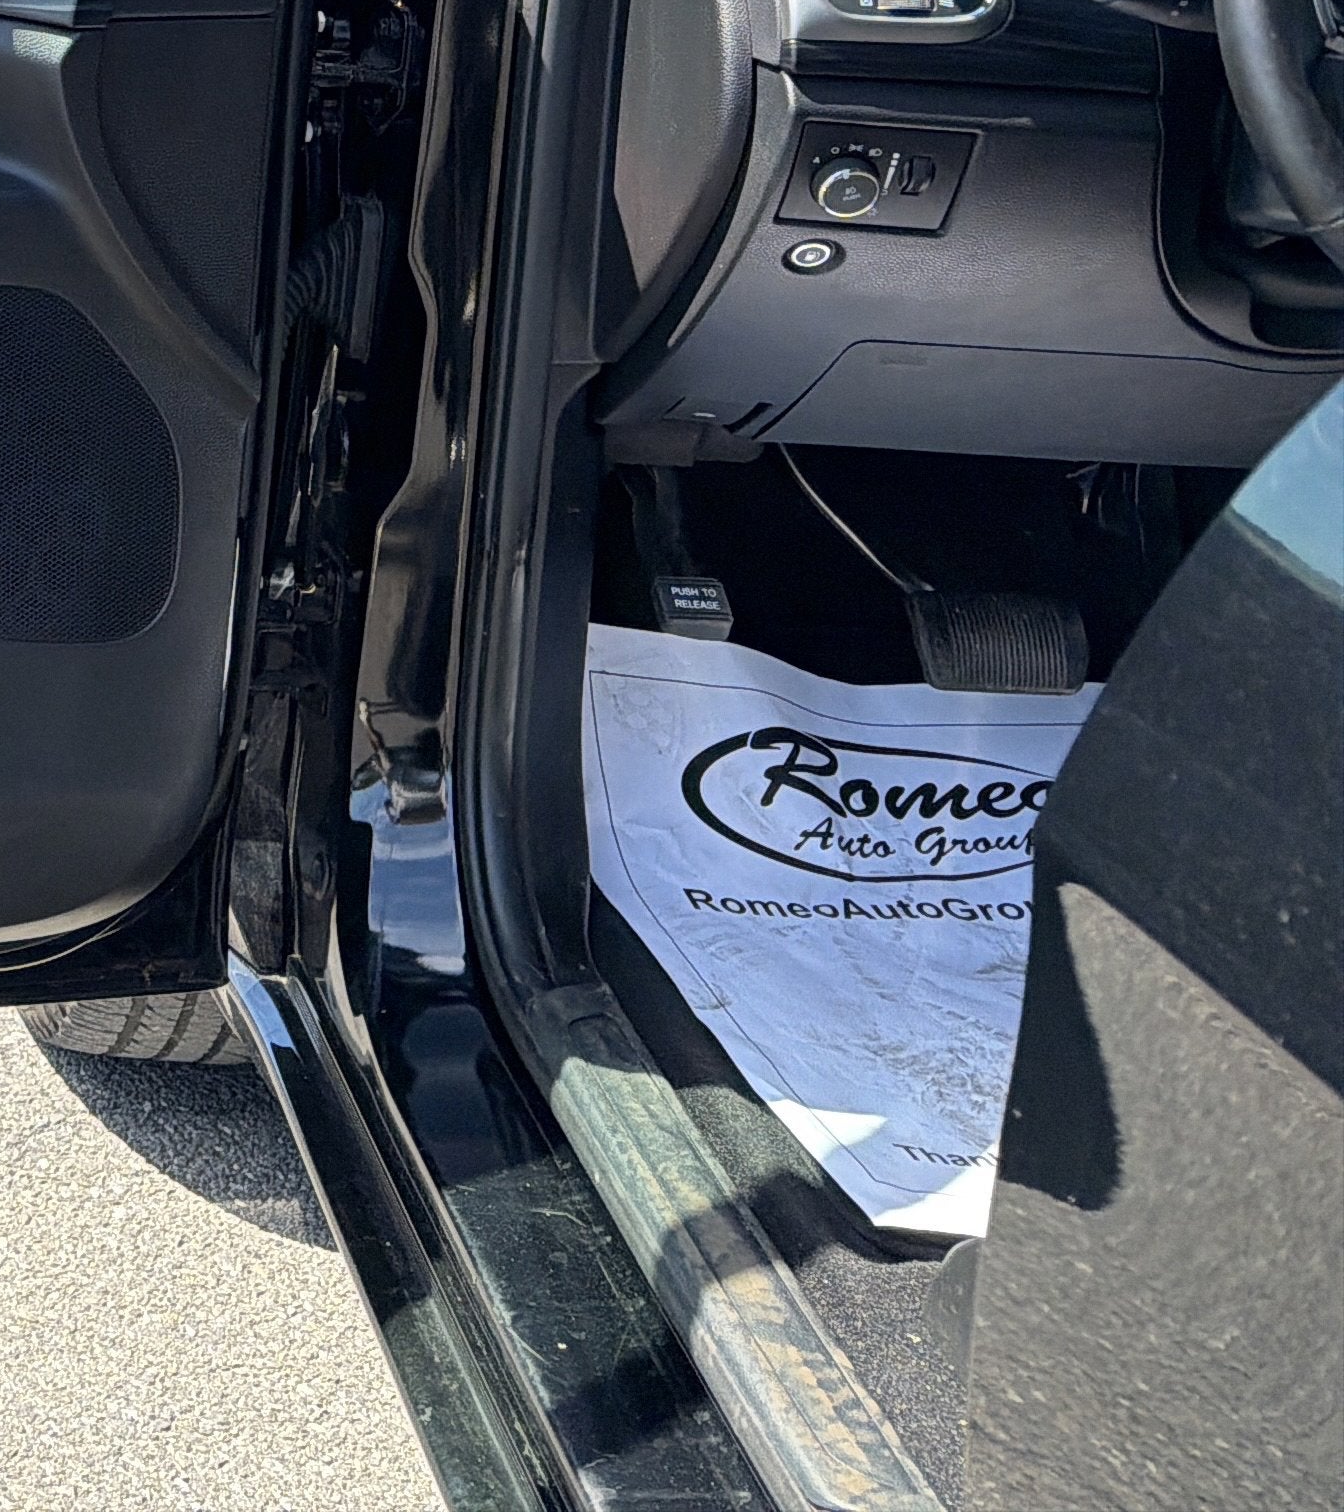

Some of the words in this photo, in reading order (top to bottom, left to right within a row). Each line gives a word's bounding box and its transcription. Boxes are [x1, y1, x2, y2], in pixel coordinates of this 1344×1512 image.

[671, 587, 699, 597] PUSH
[701, 588, 717, 597] TO
[674, 599, 721, 610] RELEASE
[794, 816, 895, 858] Auto
